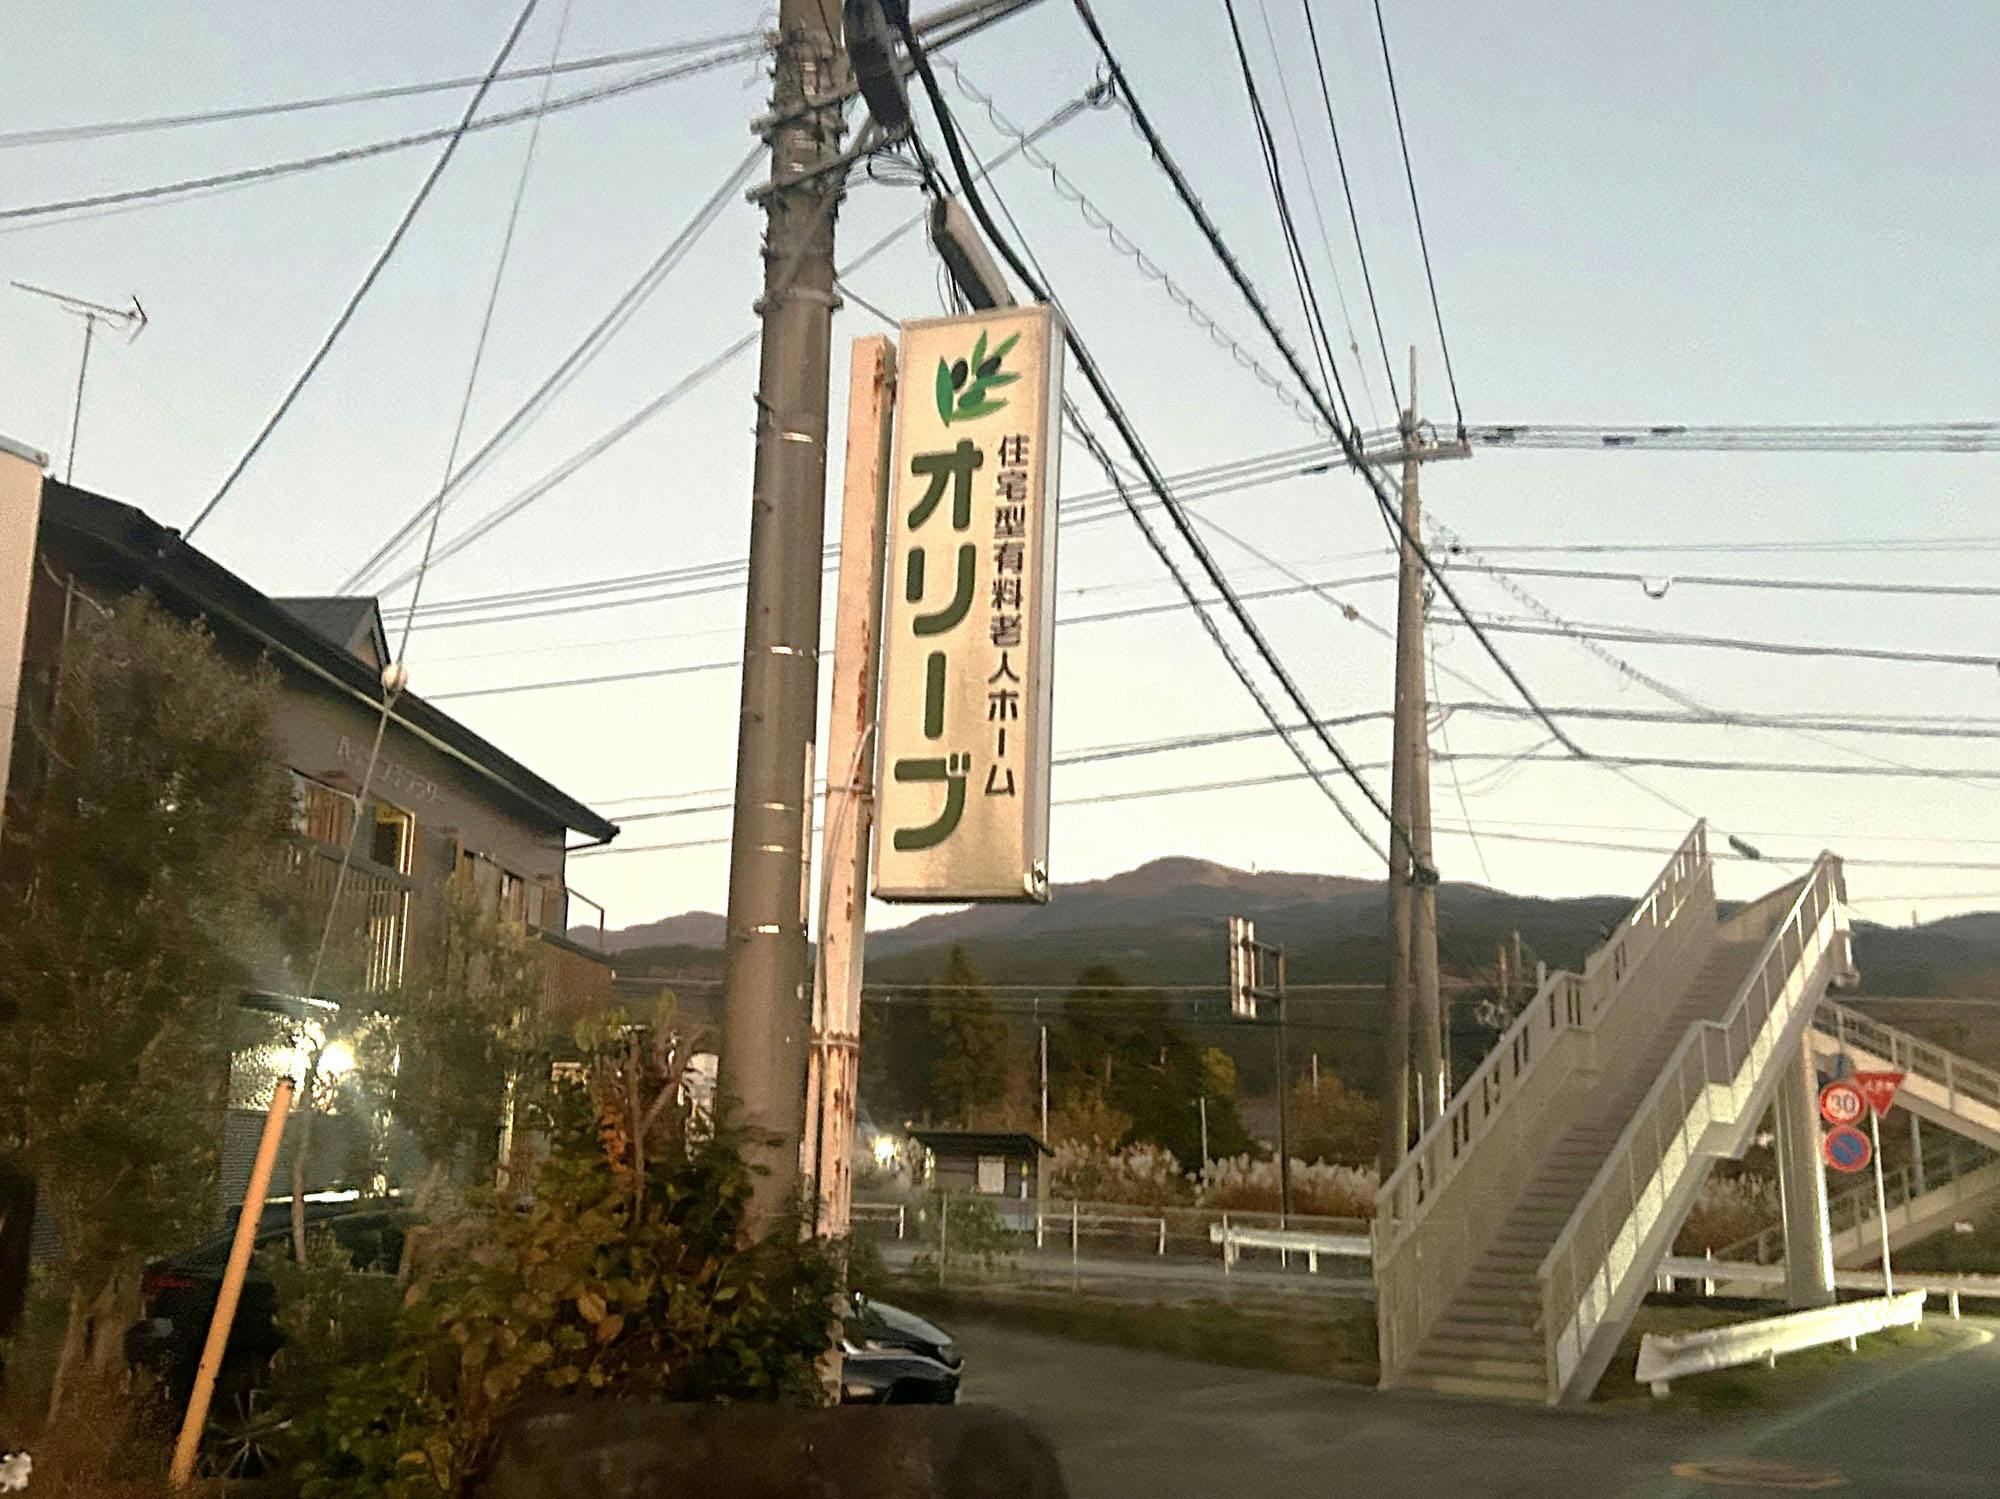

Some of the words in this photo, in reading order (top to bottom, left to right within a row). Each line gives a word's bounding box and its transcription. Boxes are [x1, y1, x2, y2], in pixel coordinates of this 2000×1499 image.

[894, 438, 984, 851] オリーブ
[984, 434, 1030, 797] 住宅型有料老人ホーム
[1831, 1094, 1857, 1113] 30
